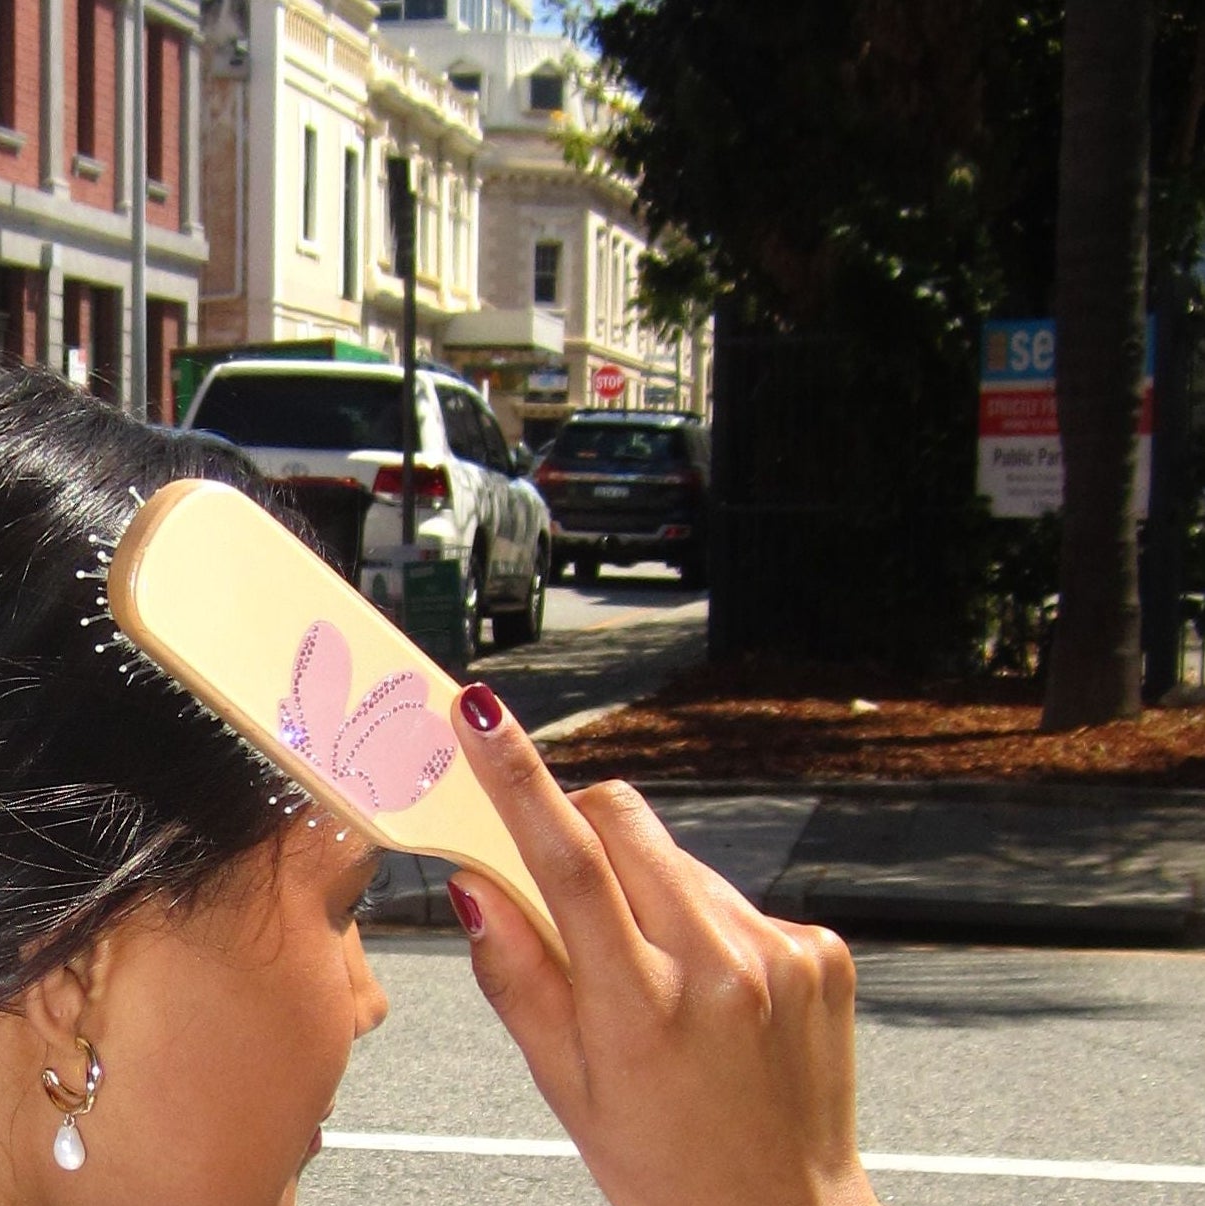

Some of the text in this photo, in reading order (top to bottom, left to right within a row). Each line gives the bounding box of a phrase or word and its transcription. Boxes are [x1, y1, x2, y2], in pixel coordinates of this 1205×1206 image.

[1010, 329, 1054, 371] se
[595, 375, 624, 389] STOP
[994, 447, 1034, 466] Public
